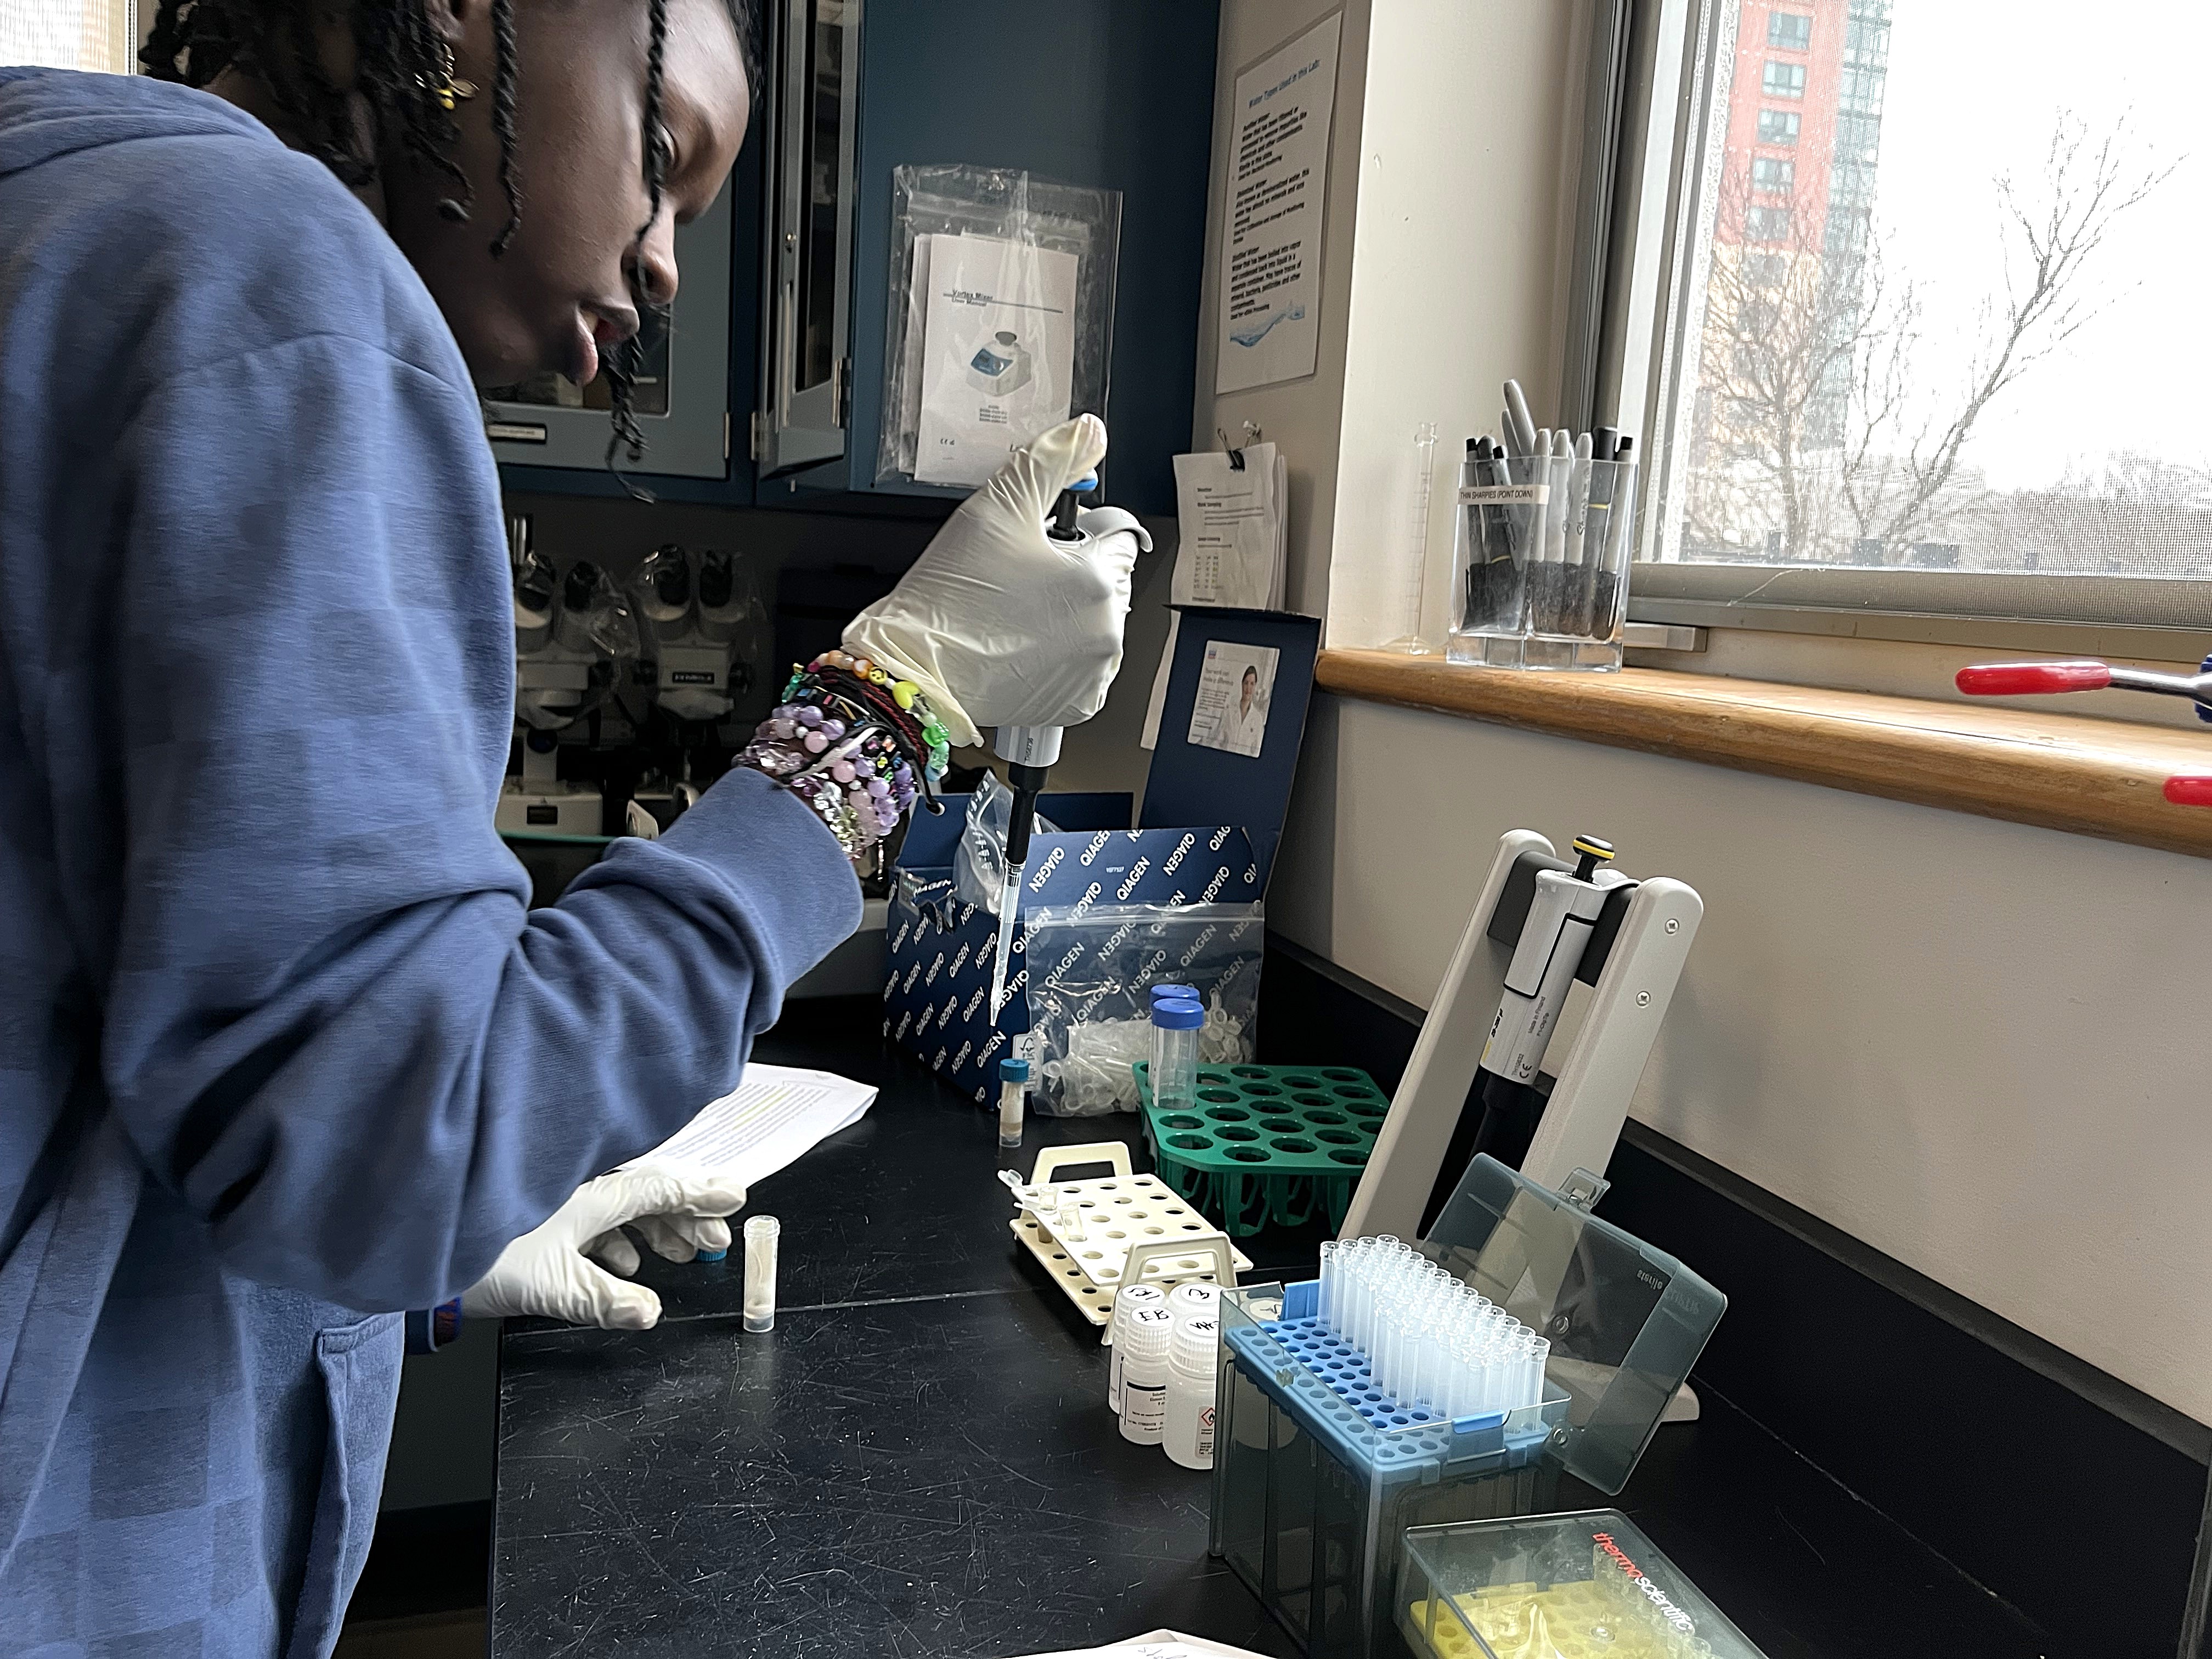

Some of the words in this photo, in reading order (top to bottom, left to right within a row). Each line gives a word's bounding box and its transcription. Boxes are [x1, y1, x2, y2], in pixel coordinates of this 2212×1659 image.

[1472, 490, 1496, 499] SHARPIES
[1497, 490, 1513, 499] (POINT
[1515, 489, 1533, 498] DOWN)
[1163, 833, 1195, 876] QIAGEN
[1210, 826, 1231, 850] QIAG
[1029, 847, 1065, 893] QIAGEN
[1117, 856, 1150, 900] QIAGEN
[893, 919, 909, 953] QIAGEN
[1013, 906, 1052, 953] QIAGEN
[1181, 924, 1217, 966] QIAGEN
[950, 941, 969, 978] QIAGEN
[975, 932, 996, 969] QIAGEN
[1045, 942, 1085, 986] QIAGEN
[884, 969, 899, 1002] QIAGEN
[904, 961, 921, 994] QIAGEN
[926, 952, 944, 986] QIAGEN
[1128, 950, 1166, 994] QIAGEN
[963, 986, 985, 1022] QIAGEN
[1000, 970, 1029, 1008] QIAG
[895, 1011, 911, 1042] QIAGEN
[916, 1002, 934, 1036] QIAGEN
[938, 995, 957, 1030] QIAGEN
[951, 1041, 971, 1074] QIAGEN
[977, 1030, 1006, 1068] QIAGEN
